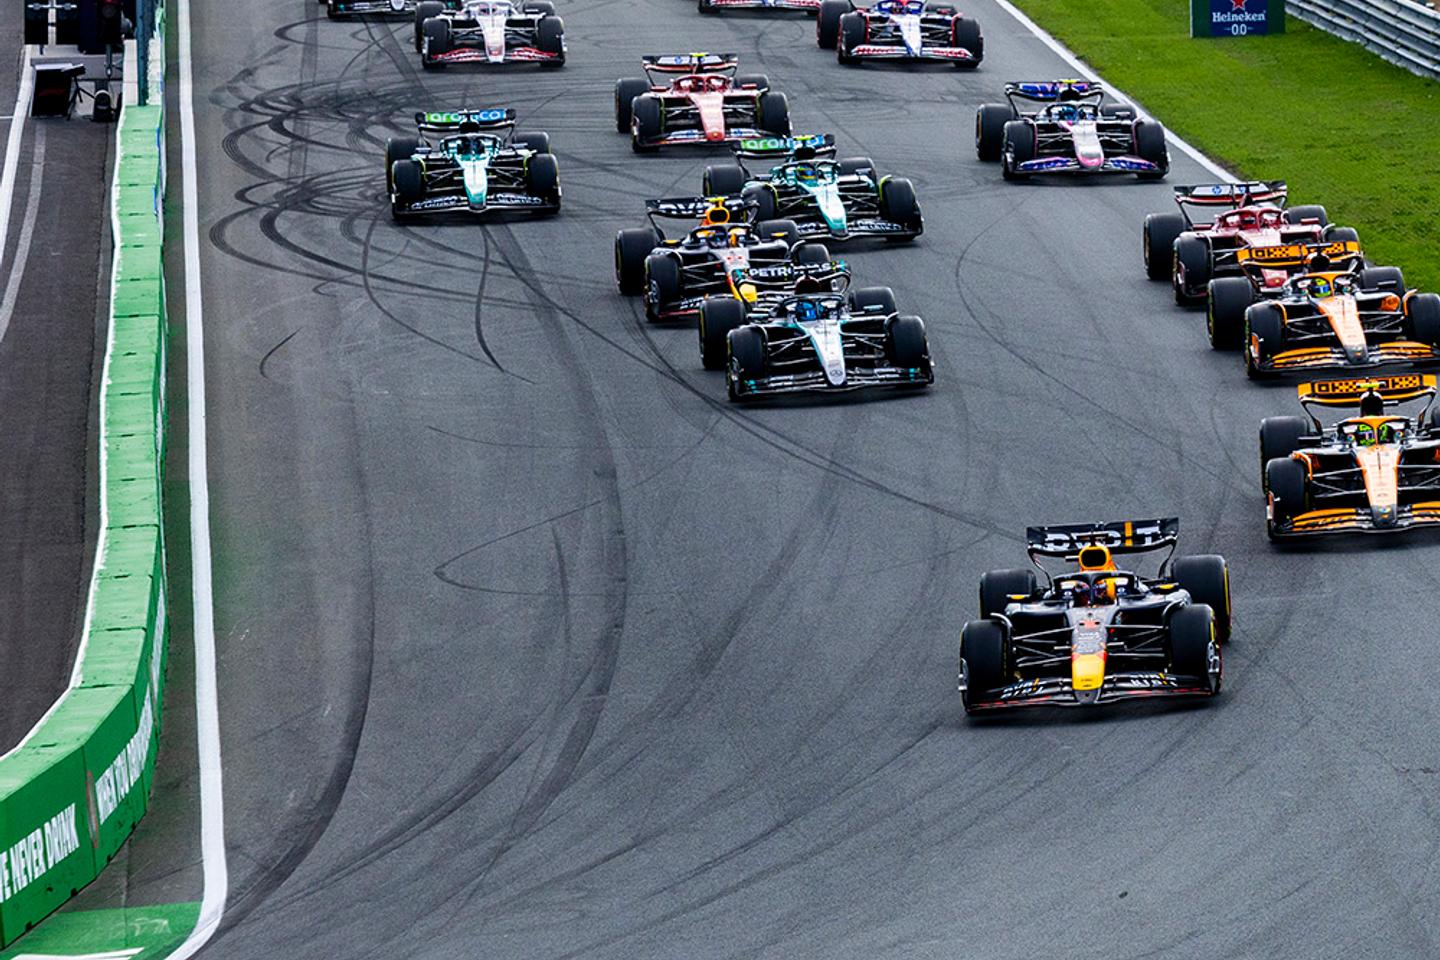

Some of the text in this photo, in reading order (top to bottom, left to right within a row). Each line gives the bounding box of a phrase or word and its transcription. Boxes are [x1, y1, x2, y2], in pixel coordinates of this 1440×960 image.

[1212, 10, 1266, 22] Heineken
[10, 827, 47, 895] NEVER
[44, 802, 80, 870] DRINK
